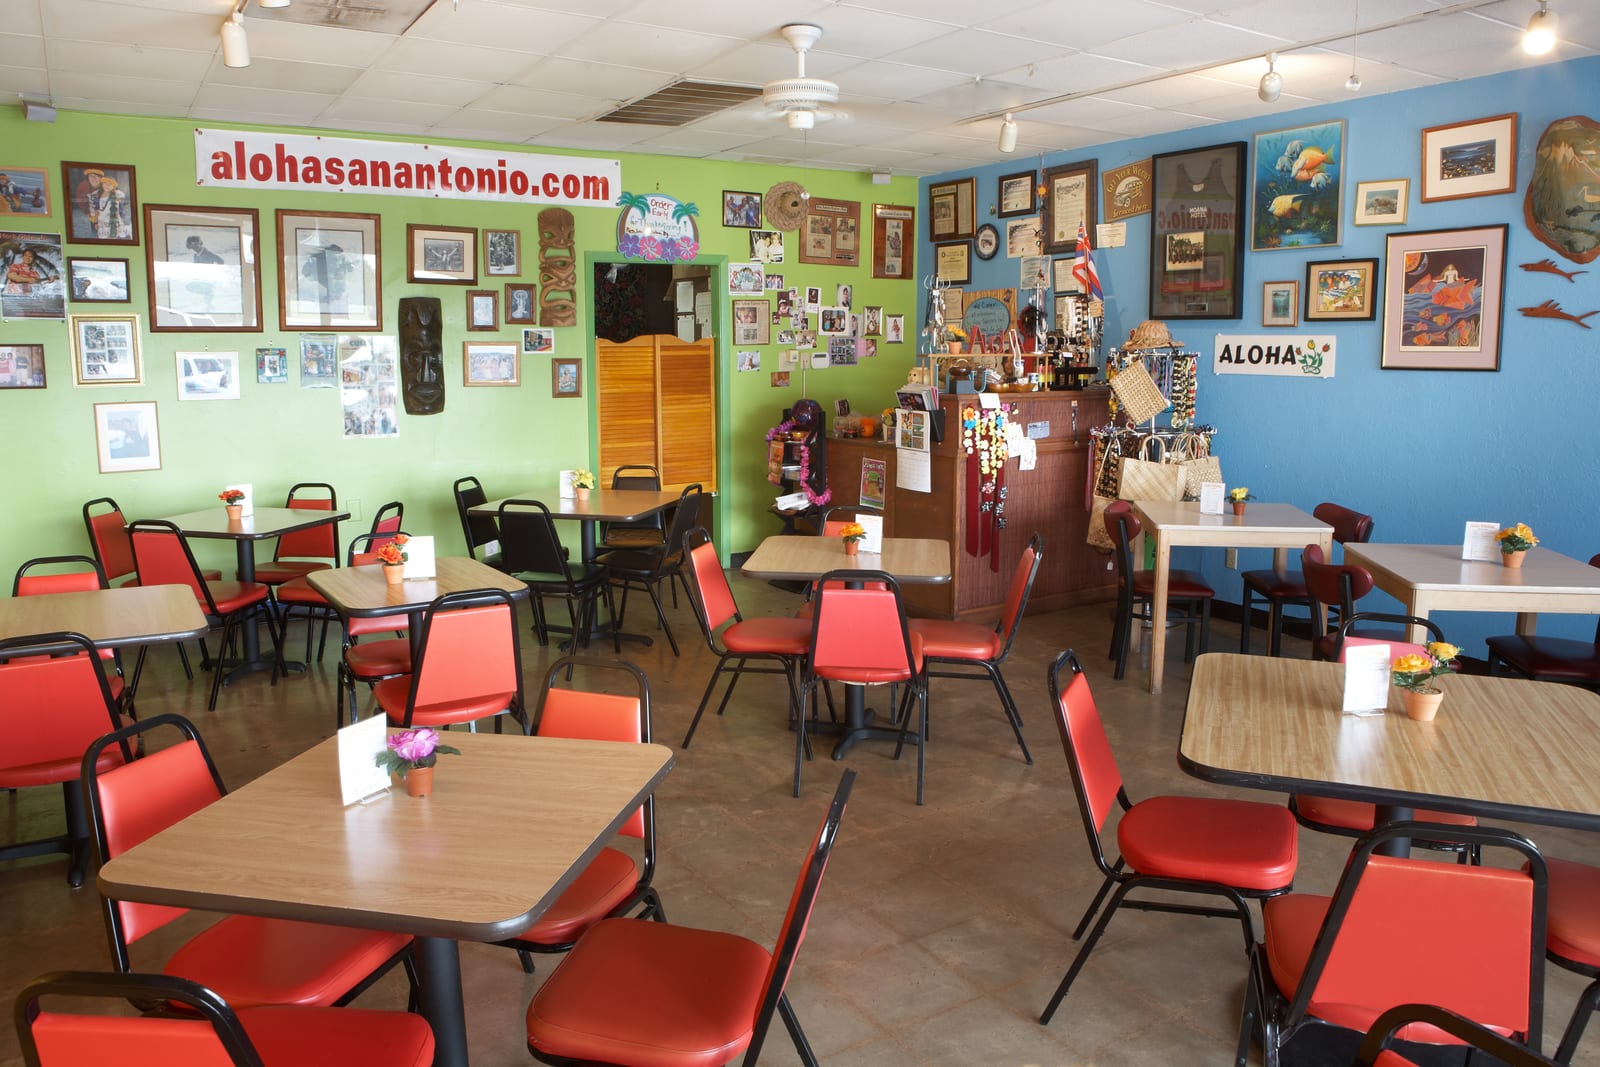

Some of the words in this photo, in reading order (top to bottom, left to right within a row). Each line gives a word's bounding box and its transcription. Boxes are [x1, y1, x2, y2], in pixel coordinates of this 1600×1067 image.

[211, 140, 610, 201] alohasanantonio.com
[650, 198, 674, 210] Order
[1219, 344, 1297, 365] ALOHA
